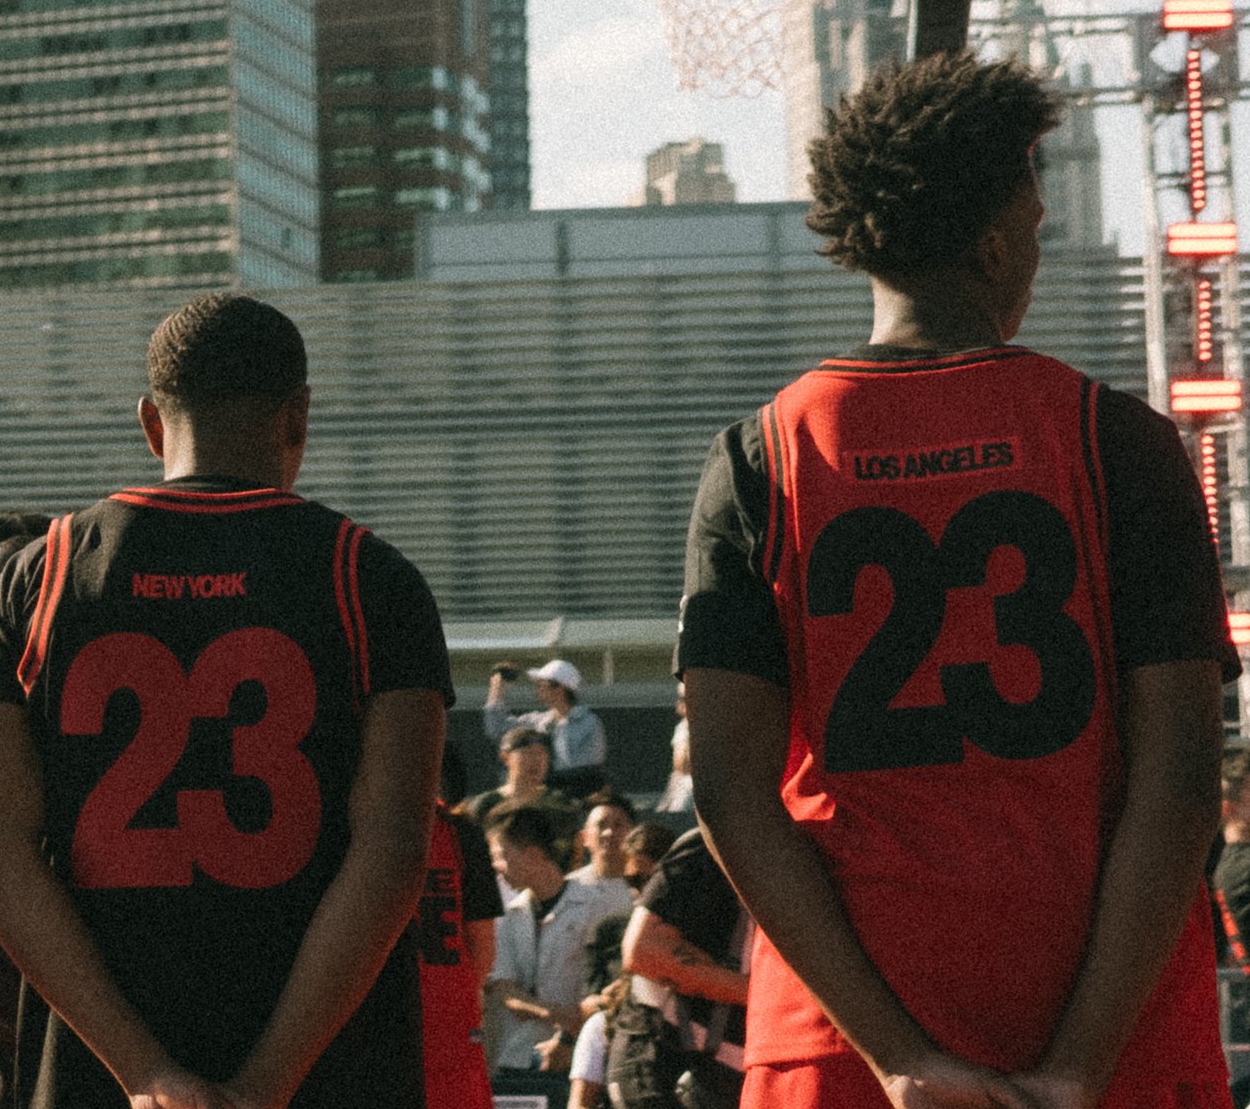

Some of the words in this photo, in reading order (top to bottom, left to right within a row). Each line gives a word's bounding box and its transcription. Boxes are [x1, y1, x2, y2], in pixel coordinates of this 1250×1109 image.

[854, 454, 901, 480] LOS
[903, 442, 1015, 478] ANGELES
[132, 572, 185, 599] NEW
[187, 572, 247, 599] YORK
[807, 489, 1097, 773] 23
[61, 628, 323, 890] 23
